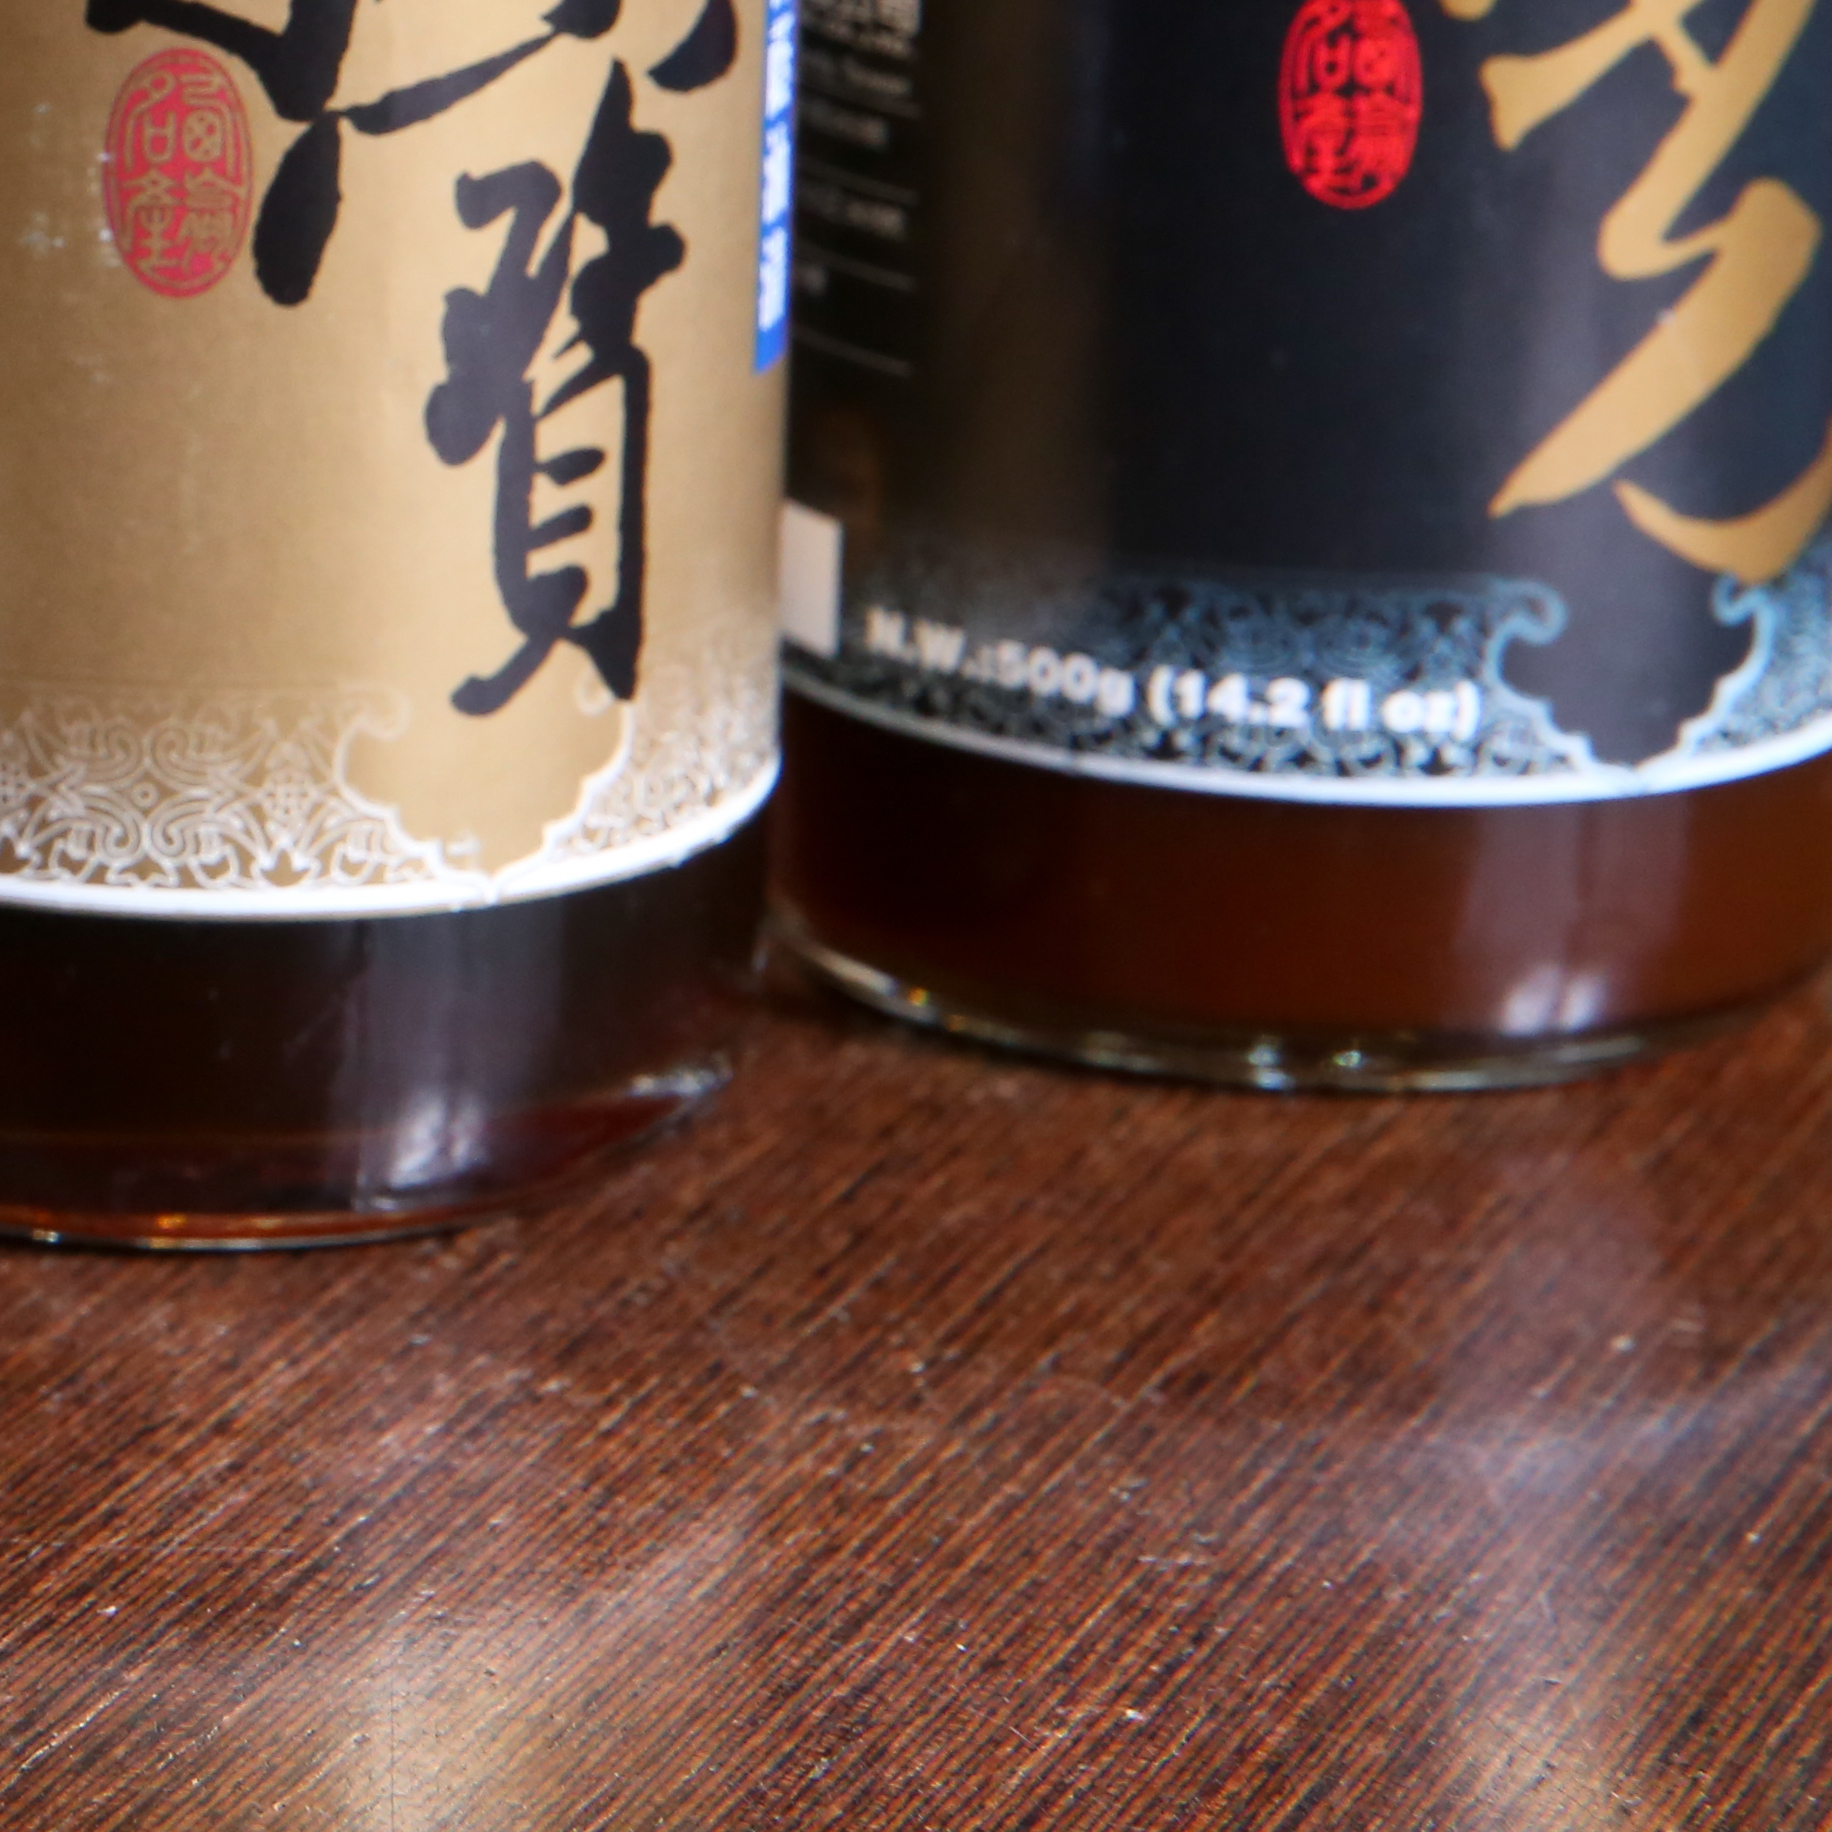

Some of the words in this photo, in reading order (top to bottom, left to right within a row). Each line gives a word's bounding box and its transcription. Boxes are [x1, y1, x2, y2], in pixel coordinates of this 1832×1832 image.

[1146, 667, 1311, 728] (14.2
[1322, 676, 1370, 731] fl
[1380, 678, 1481, 742] oz)
